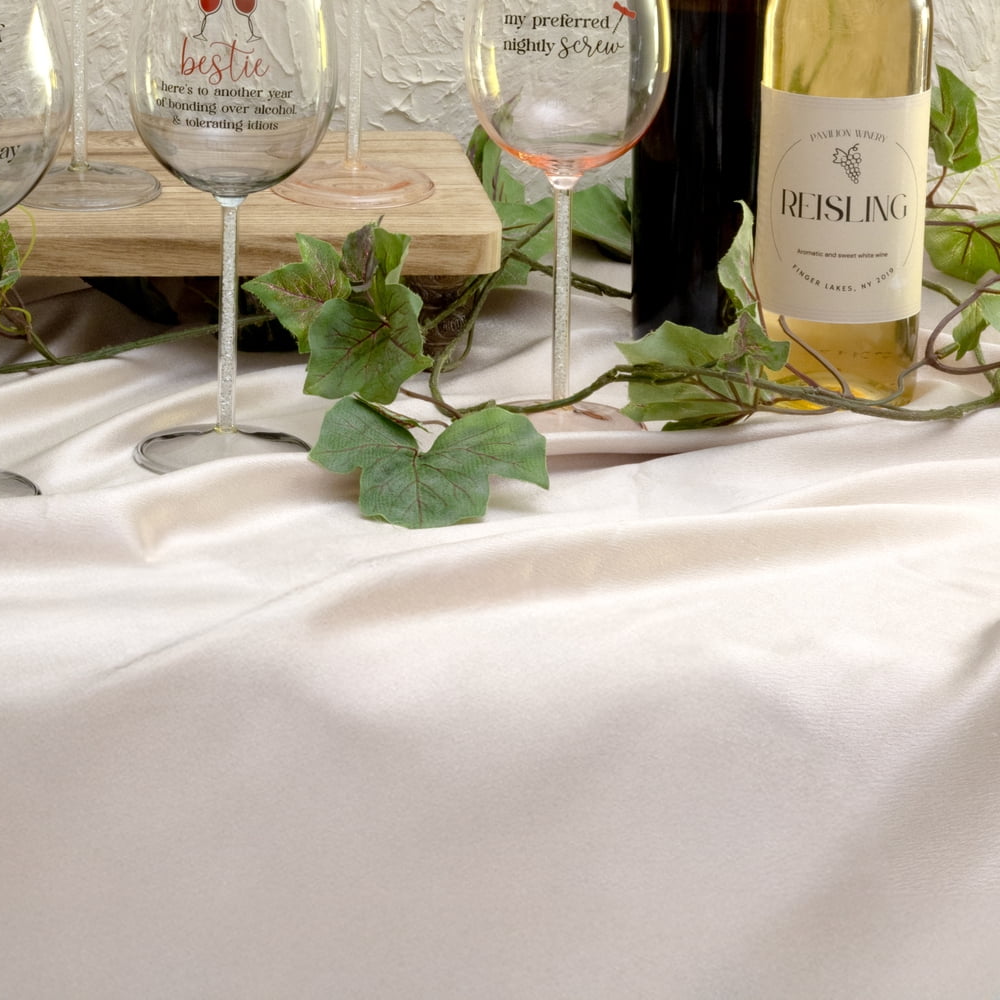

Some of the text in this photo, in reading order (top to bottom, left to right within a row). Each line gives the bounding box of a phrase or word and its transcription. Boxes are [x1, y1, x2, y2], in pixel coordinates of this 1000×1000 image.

[504, 13, 610, 30] my preferred
[503, 38, 555, 56] nightly
[180, 37, 270, 85] bestie
[161, 80, 293, 101] here's to another year
[155, 97, 166, 107] of
[168, 98, 217, 115] bonding
[221, 105, 249, 114] over
[172, 115, 279, 132] & tolerating idiots
[809, 128, 888, 144] PAVILION WINERY
[780, 188, 908, 223] REISLING
[797, 248, 824, 257] Aromatic
[792, 263, 821, 286] FINGER
[860, 281, 873, 289] NY
[876, 267, 895, 284] 2019
